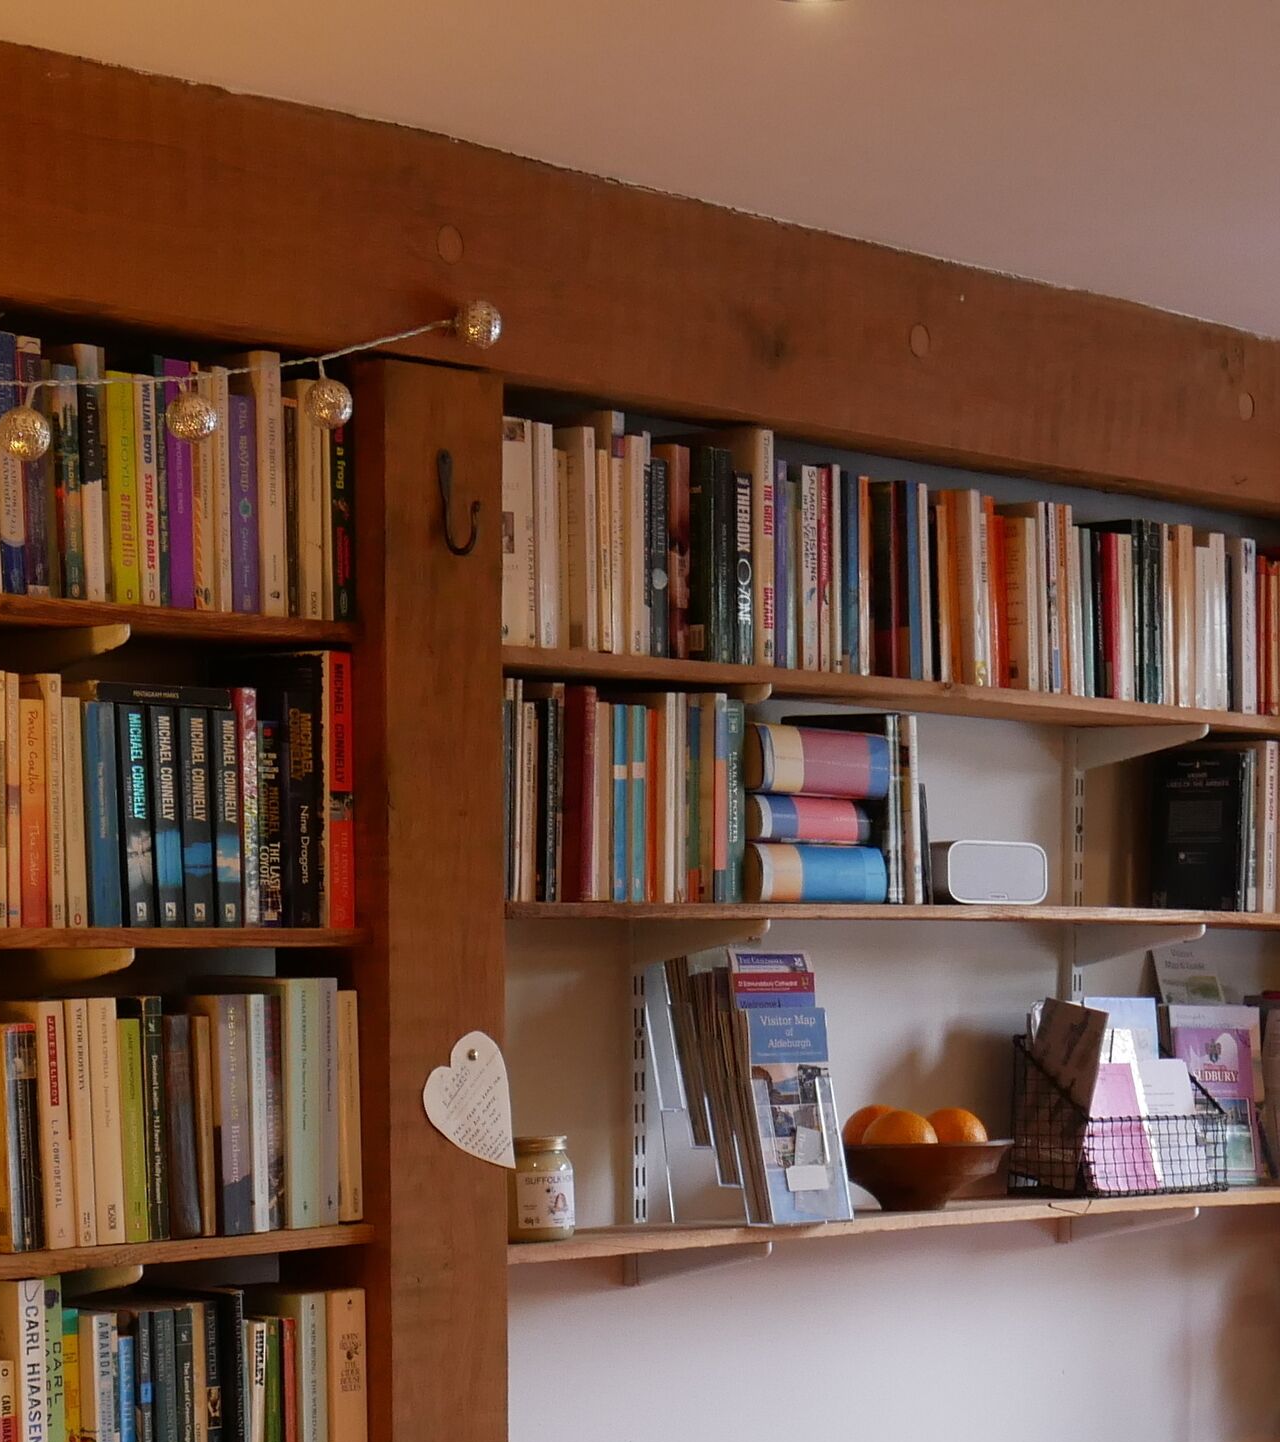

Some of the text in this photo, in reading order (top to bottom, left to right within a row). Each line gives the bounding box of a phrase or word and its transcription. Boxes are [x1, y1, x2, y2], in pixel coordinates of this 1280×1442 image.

[142, 384, 154, 509] WILLIAM BOYD STARS
[656, 466, 666, 556] DONNA TARTT
[736, 488, 751, 552] THEROUX
[807, 471, 817, 582] SALMON FISHING
[764, 485, 774, 630] THE GREAT BAZAAR
[804, 521, 812, 568] YEMEN
[128, 714, 146, 820] MICHAEL CONNELLY
[157, 711, 175, 816] MICHAEL CONNELLY
[190, 718, 207, 822] MICHAEL CONNELLY
[222, 721, 237, 823] MICHAEL CONNELLY
[299, 806, 309, 834] Nine
[760, 1015, 816, 1027] Visitor Map
[767, 1038, 811, 1049] Aldeburgh
[785, 1028, 794, 1036] of
[1193, 1070, 1238, 1082] SUDBURY
[25, 1305, 39, 1355] CARL
[97, 1321, 107, 1377] AMANDA
[254, 1329, 266, 1386] HUXLEY
[53, 1342, 64, 1404] CARL
[2, 1395, 11, 1417] CARL
